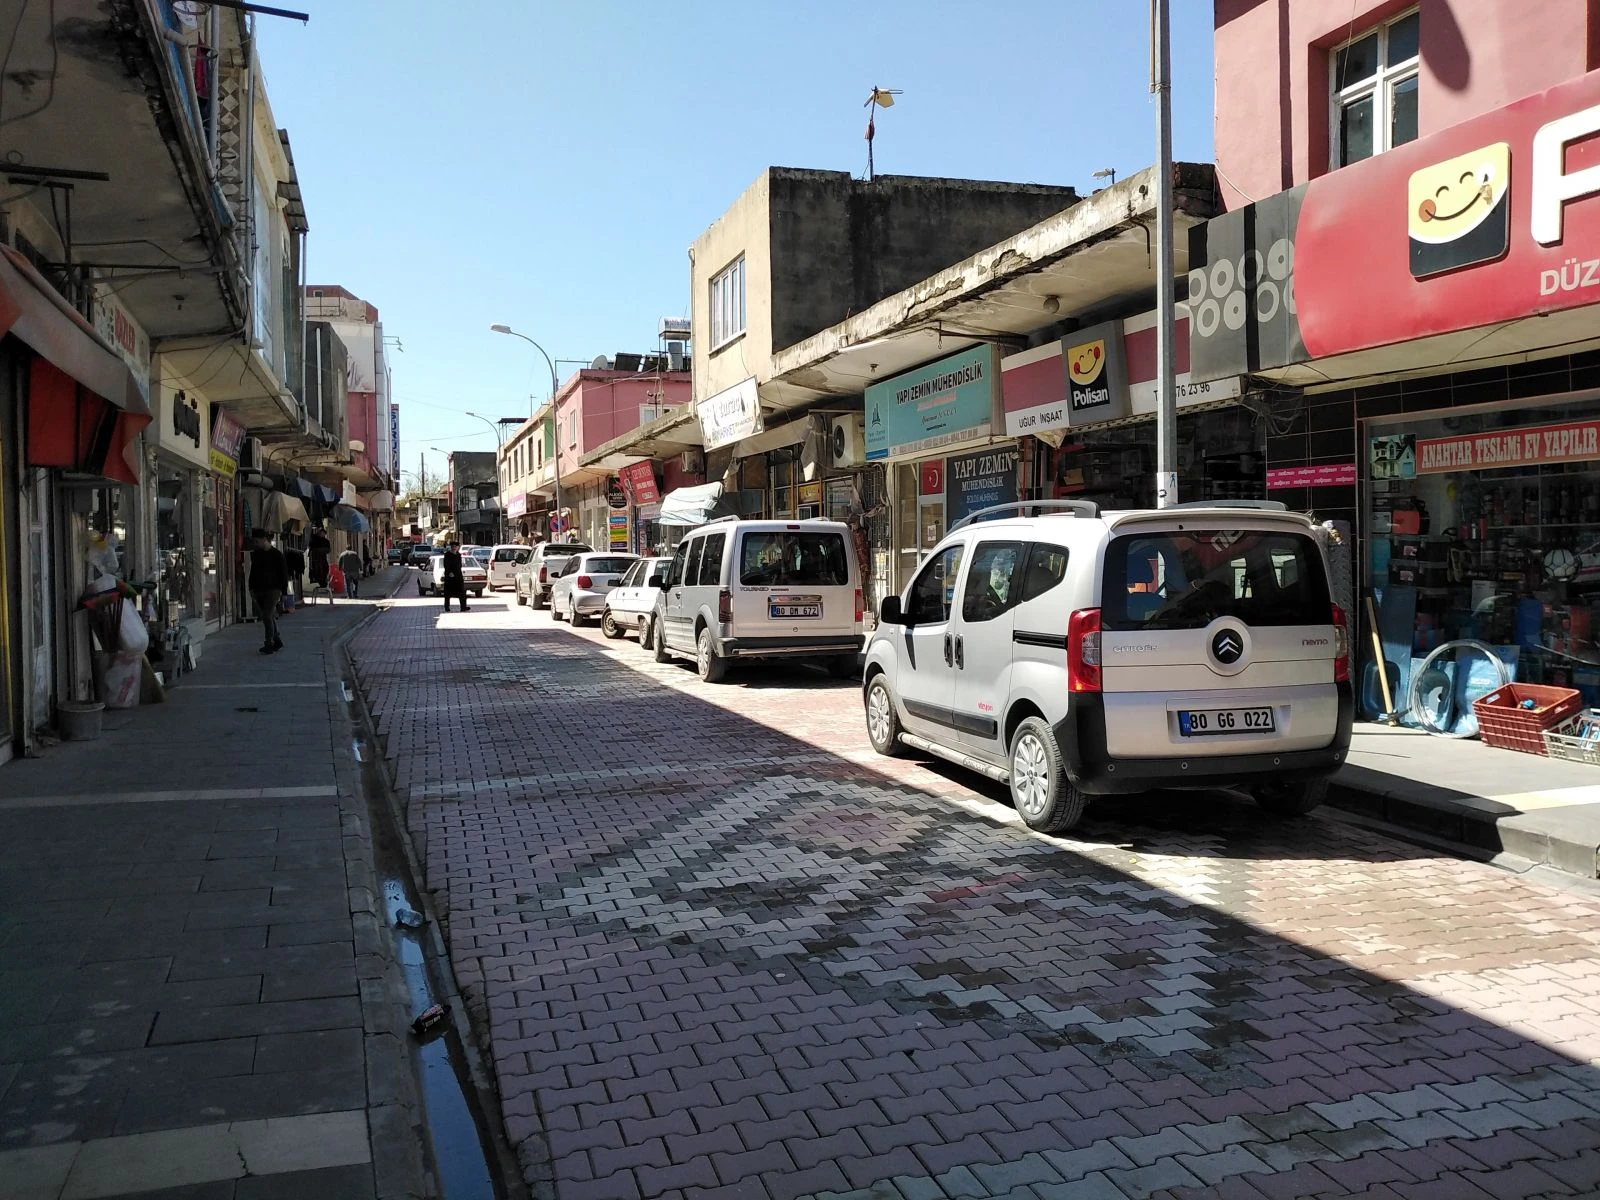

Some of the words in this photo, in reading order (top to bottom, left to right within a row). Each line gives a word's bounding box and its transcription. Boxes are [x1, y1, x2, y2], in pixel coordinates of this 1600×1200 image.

[896, 390, 909, 404] YAPI
[1073, 388, 1108, 407] Polisan
[1422, 441, 1472, 468] ANAHTAR
[1524, 433, 1540, 459] EV
[1544, 427, 1597, 458] YAPILIR
[954, 459, 976, 479] YAPI
[1190, 713, 1207, 729] 80
[1217, 712, 1235, 728] GG
[1244, 711, 1269, 727] 022
